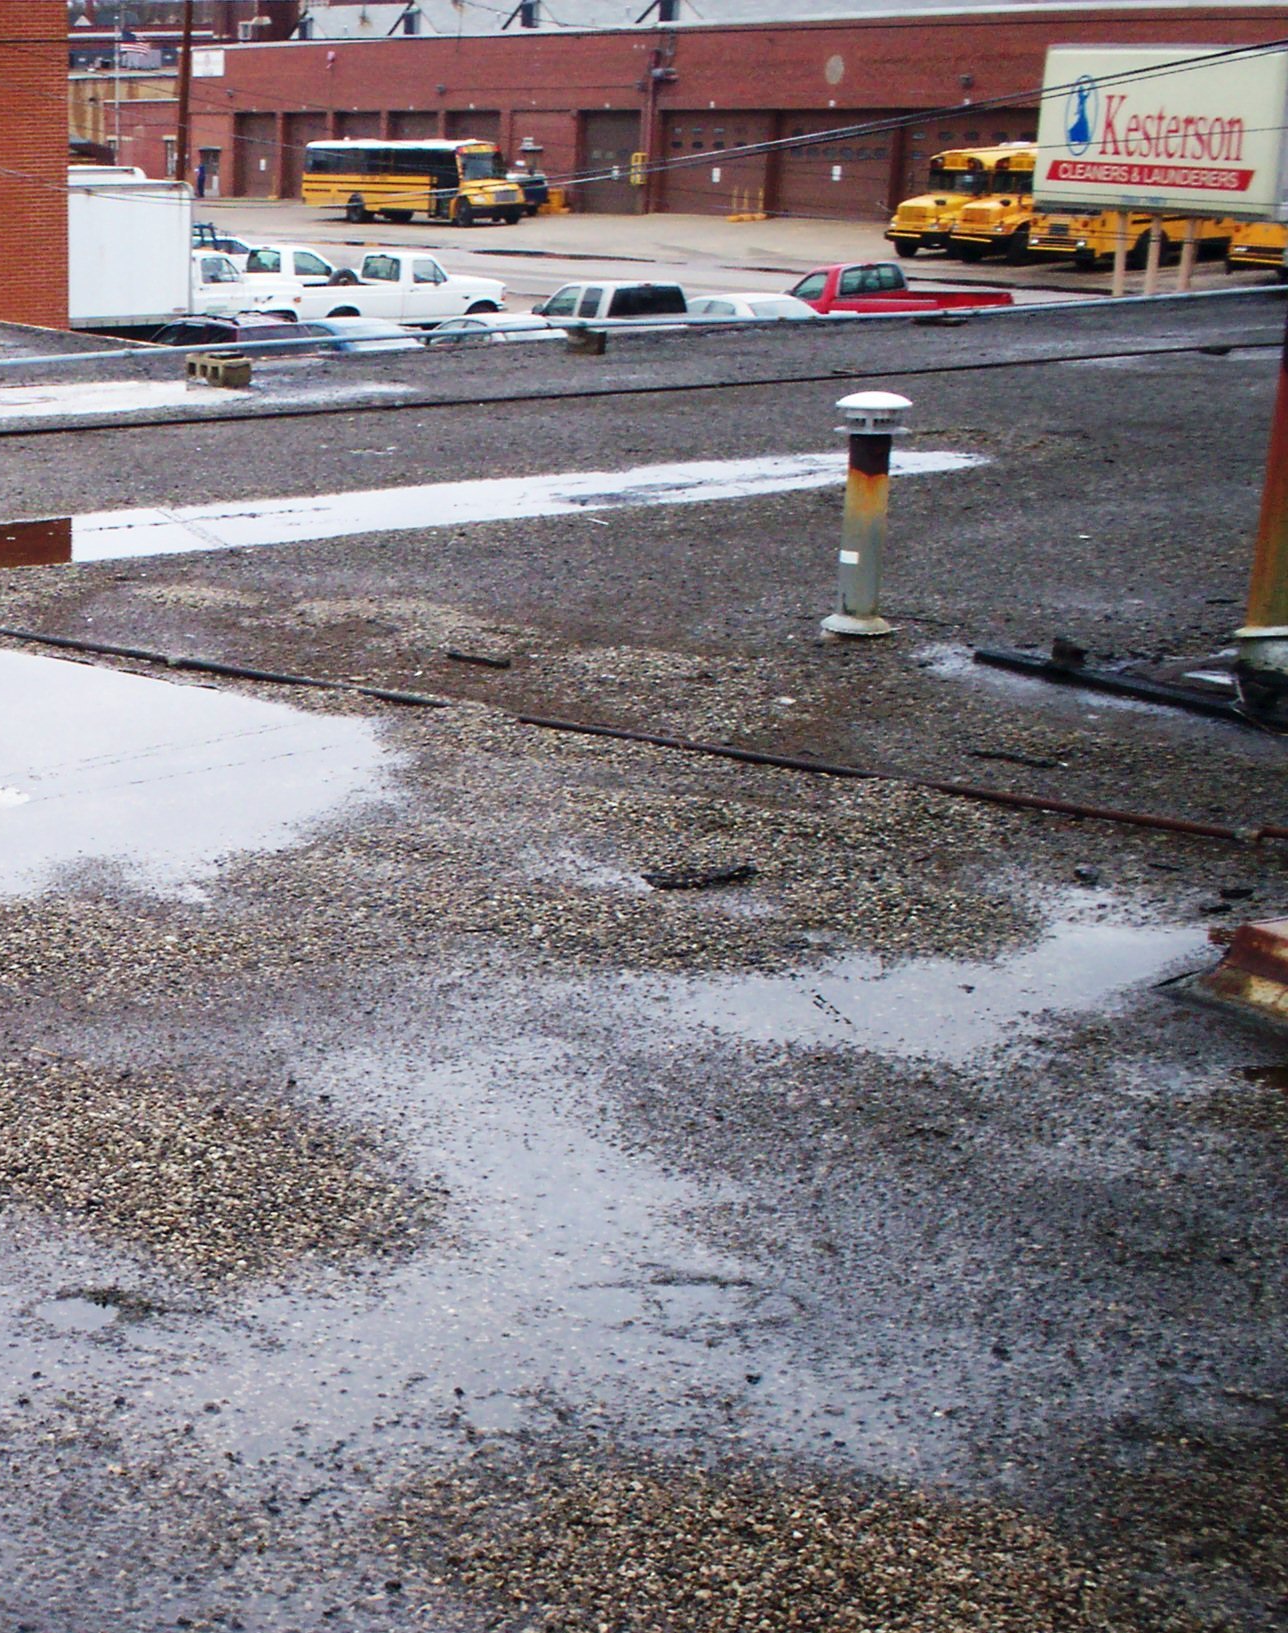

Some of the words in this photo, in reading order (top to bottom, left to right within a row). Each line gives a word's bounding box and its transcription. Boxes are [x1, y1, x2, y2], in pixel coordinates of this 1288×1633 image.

[1099, 94, 1243, 161] Kesterson
[1058, 163, 1129, 182] CLEANERS
[1131, 168, 1141, 182] &
[1143, 169, 1239, 188] LAUNDERERS
